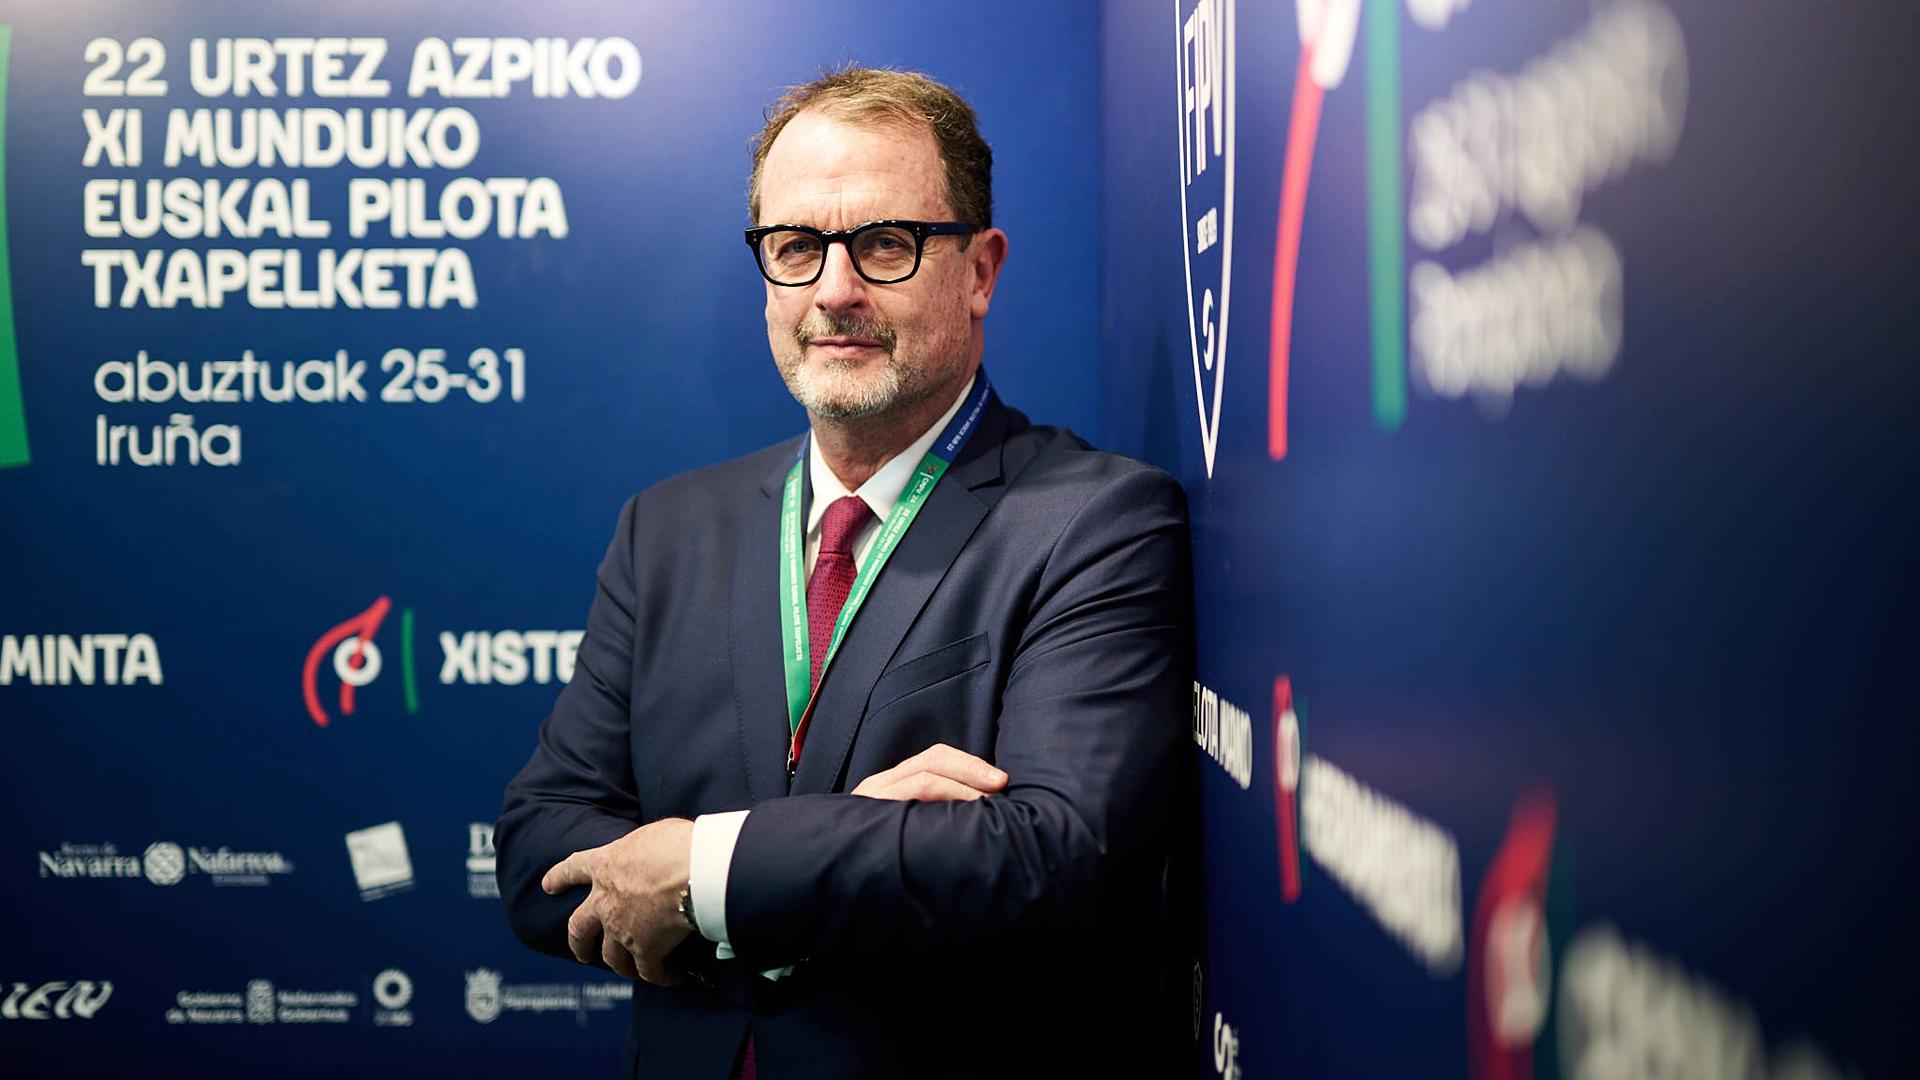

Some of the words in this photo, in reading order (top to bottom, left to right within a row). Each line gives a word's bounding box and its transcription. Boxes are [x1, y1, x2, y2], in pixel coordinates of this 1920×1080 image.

[83, 36, 167, 96] 22
[190, 38, 390, 96] URTEZ
[409, 35, 642, 98] AZPIKO
[82, 109, 142, 166] XI
[164, 107, 480, 168] MUNDUKO
[84, 178, 330, 238] EUSKAL
[349, 177, 568, 238] PILOTA
[82, 248, 477, 308] TXAPELKETA
[95, 350, 366, 402] abuztuak
[381, 348, 524, 402] 25-31
[97, 413, 240, 466] Iruña
[0, 634, 162, 685] MINTA
[438, 629, 586, 685] XISTE
